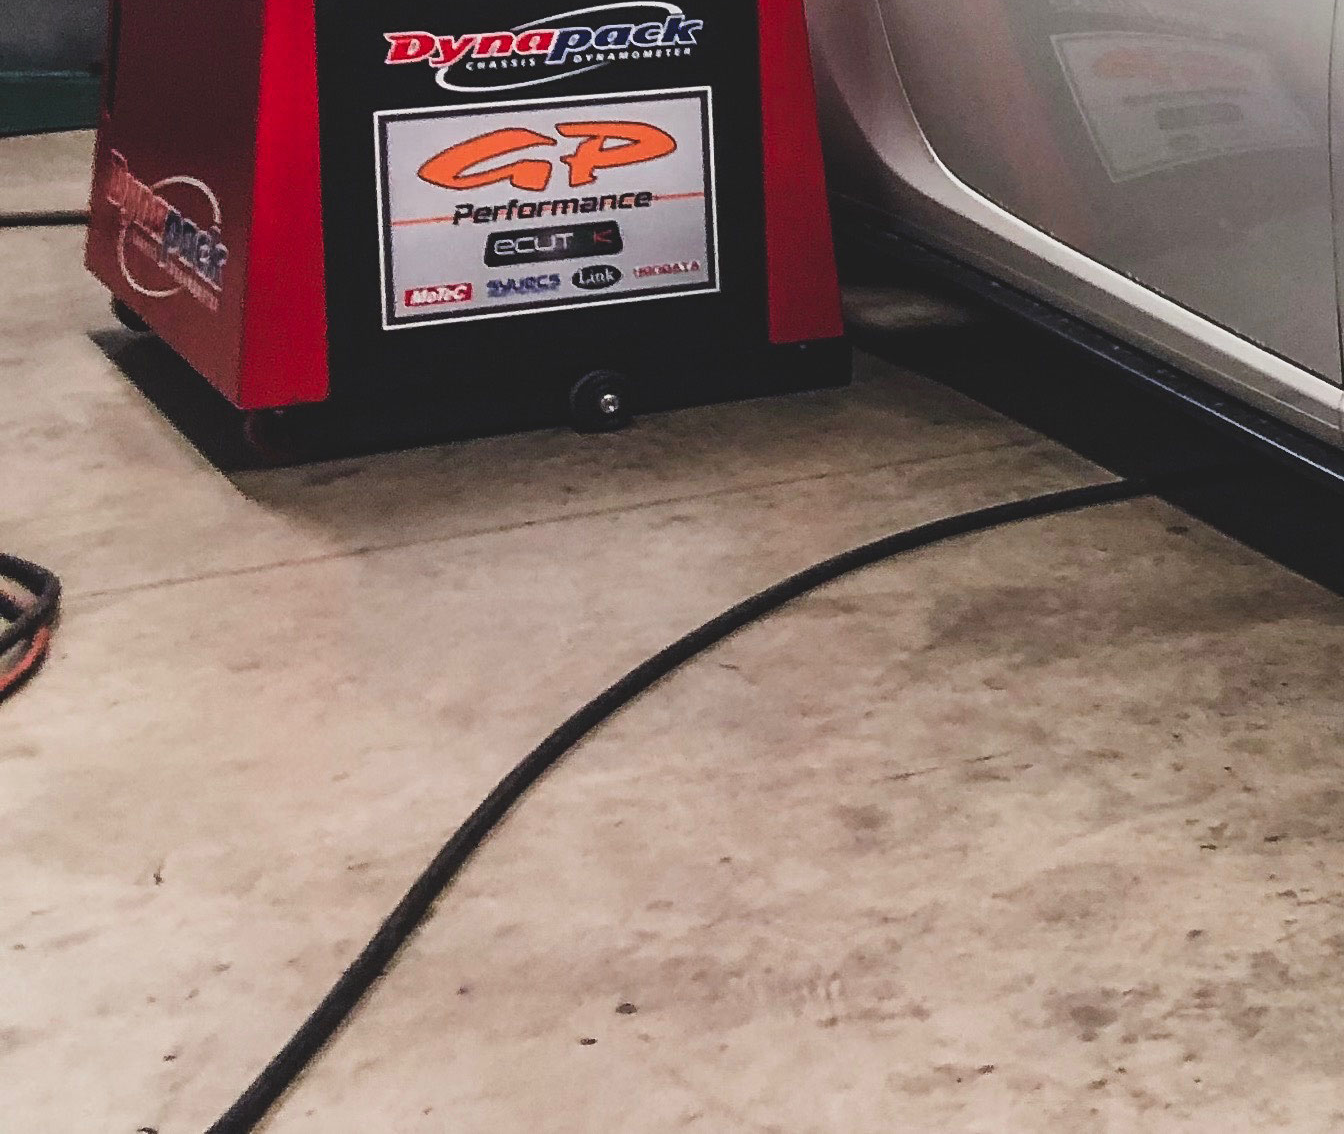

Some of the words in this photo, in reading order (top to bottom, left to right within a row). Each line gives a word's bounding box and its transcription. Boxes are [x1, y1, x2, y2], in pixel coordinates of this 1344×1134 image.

[383, 14, 703, 68] Dynapack
[466, 57, 536, 71] CHASSIS
[573, 47, 692, 64] DYNAMOMETER
[417, 120, 678, 192] GP
[452, 191, 653, 226] Performance
